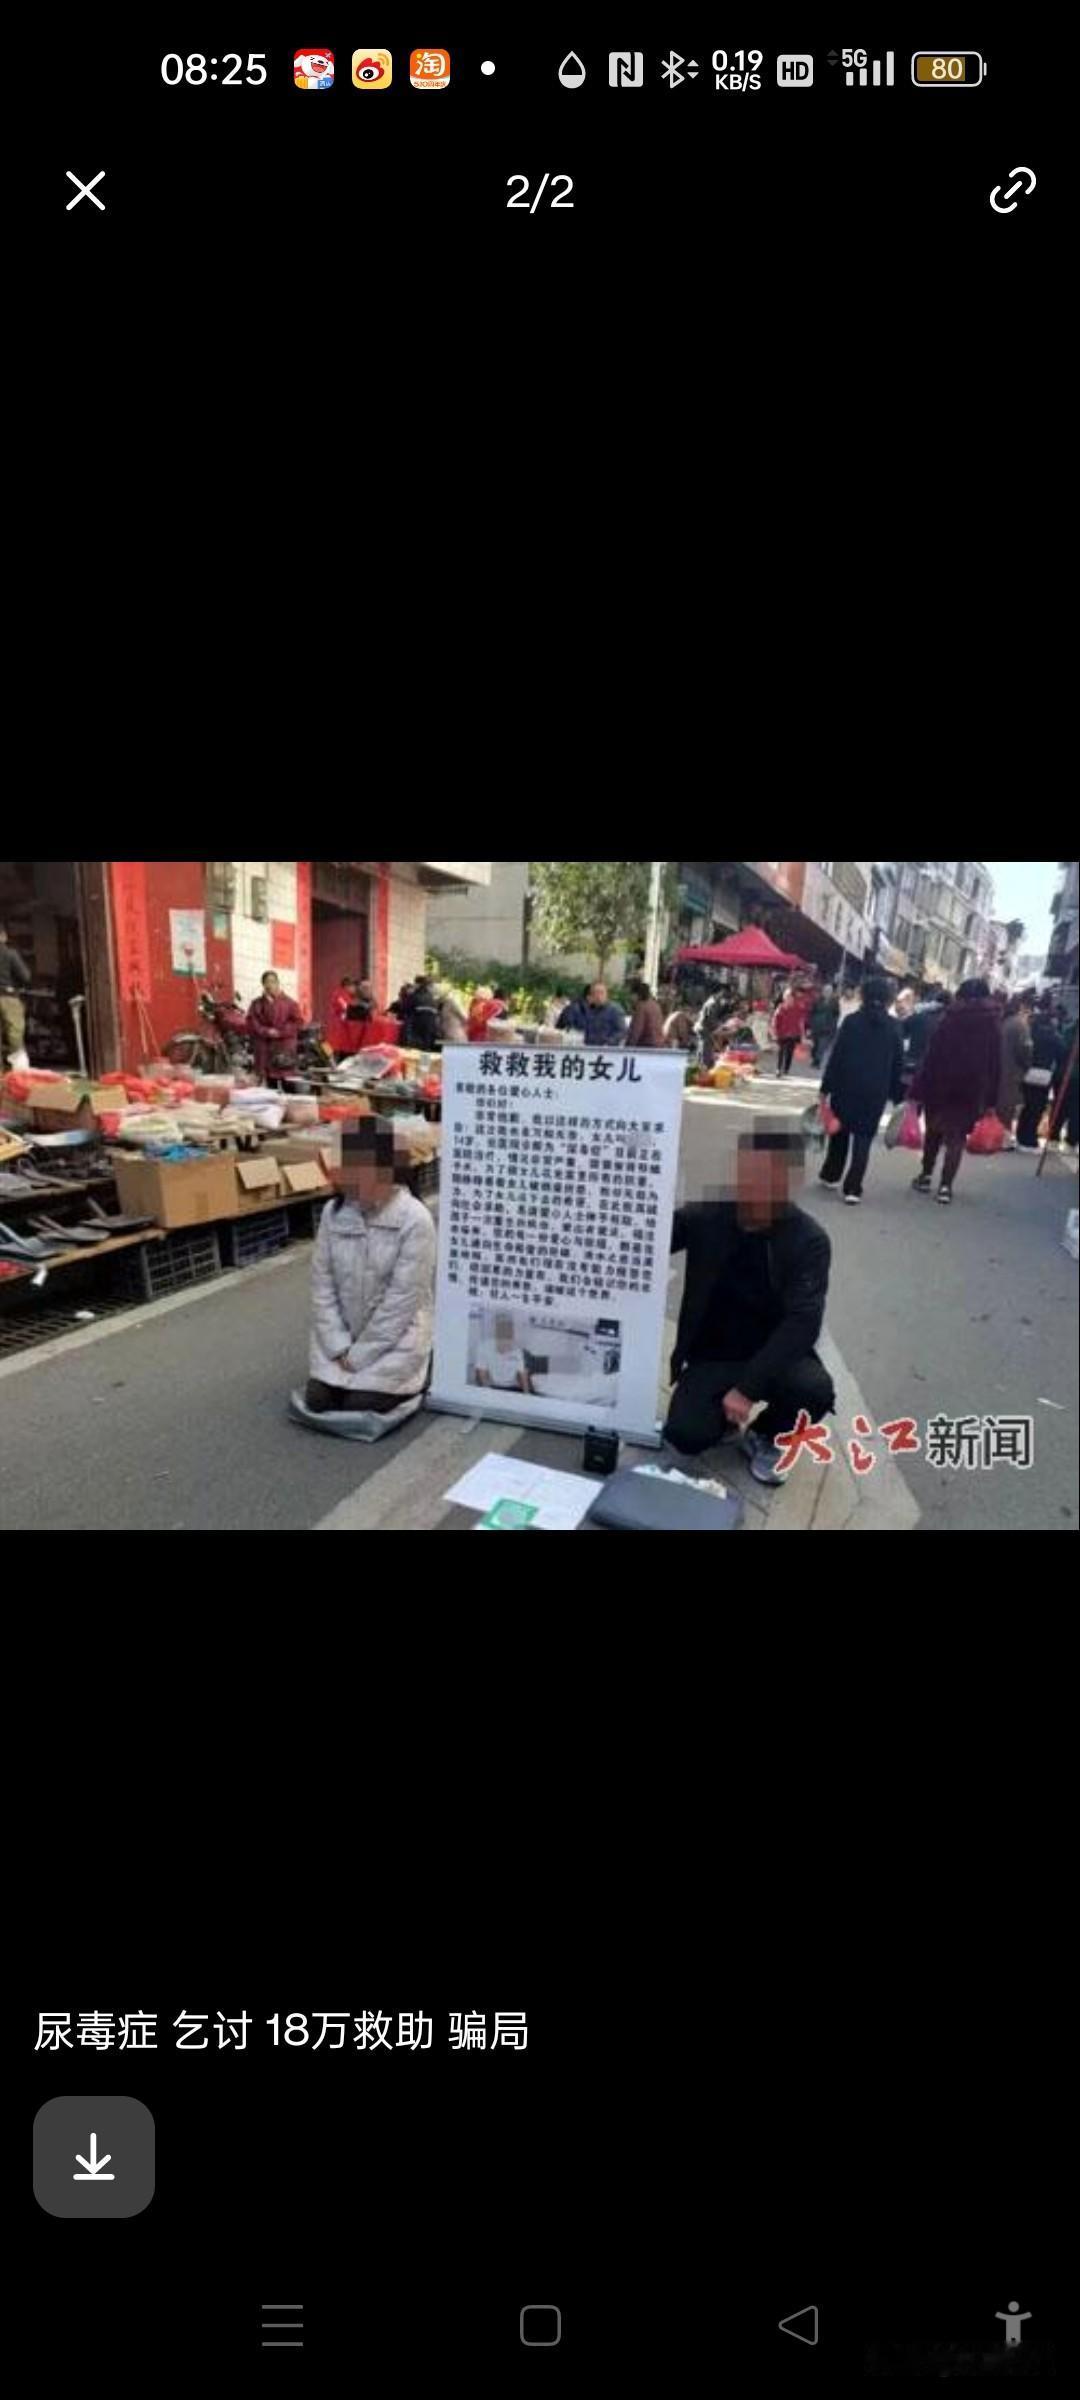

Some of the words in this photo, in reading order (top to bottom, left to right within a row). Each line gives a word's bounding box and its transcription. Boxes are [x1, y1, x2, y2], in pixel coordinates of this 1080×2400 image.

[160, 53, 267, 86] 08:25
[415, 52, 446, 77] 淘
[711, 50, 764, 72] 0.19
[841, 48, 868, 68] 5G
[930, 58, 963, 80] 80
[714, 73, 762, 92] KB/S
[781, 61, 809, 81] HD
[506, 173, 574, 214] 2/2
[479, 1050, 642, 1082] 救救我的女儿
[33, 2009, 158, 2051] 尿毒症
[172, 2009, 253, 2050] 乞讨
[266, 2009, 433, 2051] 18万救助
[448, 2009, 528, 2051] 骗局
